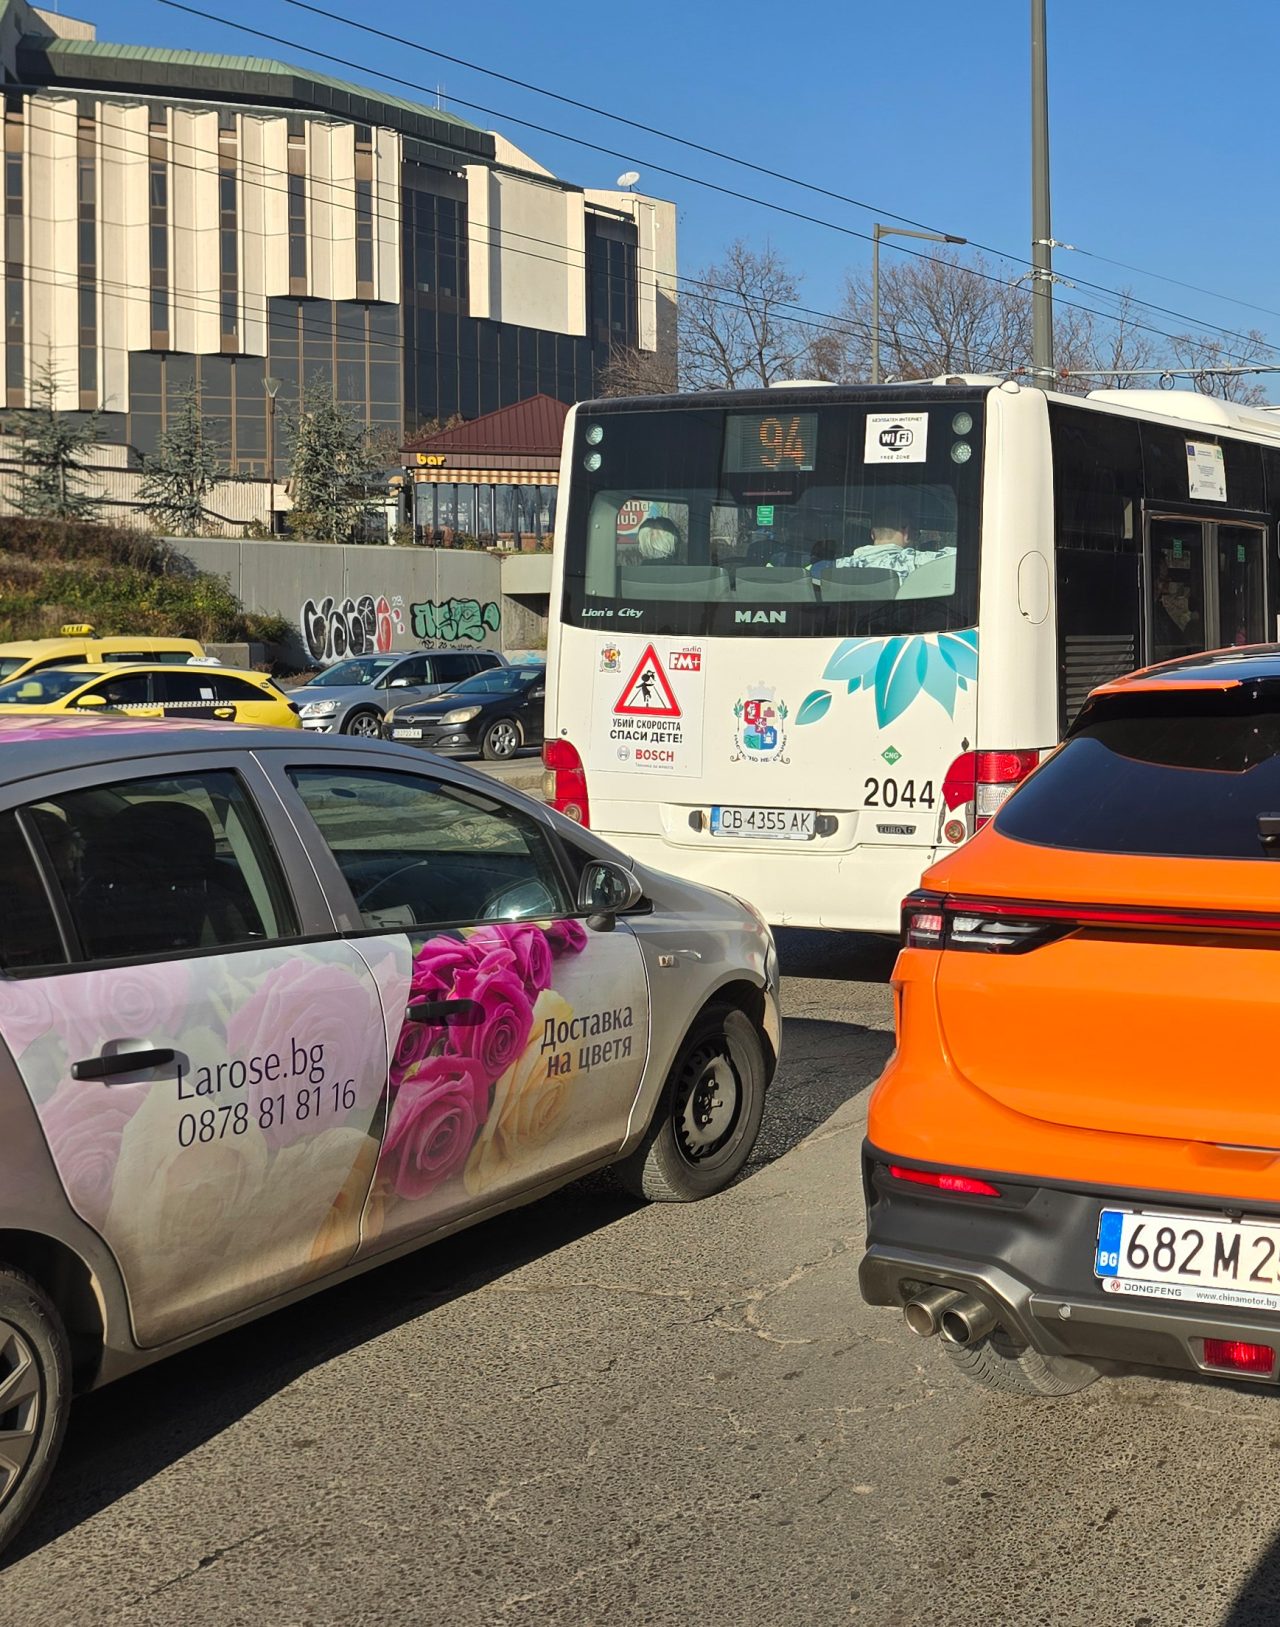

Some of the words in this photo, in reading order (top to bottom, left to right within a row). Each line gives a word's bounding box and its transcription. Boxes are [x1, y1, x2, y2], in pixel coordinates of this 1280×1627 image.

[759, 416, 806, 468] 94
[416, 453, 446, 466] bar
[582, 608, 613, 617] Lion's
[617, 608, 643, 618] City
[735, 610, 786, 623] MAN
[669, 653, 701, 671] FM+
[613, 717, 634, 729] УБИЙ
[637, 719, 681, 731] СКОРОСТТА
[610, 730, 648, 741] СПАСИ
[650, 732, 683, 743] ДЕТЕ!
[635, 749, 674, 761] BOSCH
[884, 751, 899, 760] CNG
[863, 777, 935, 809] 2044
[721, 810, 742, 829] CB
[747, 811, 786, 830] 4355
[790, 812, 811, 832] AK
[541, 1006, 633, 1055] Доставка
[547, 1051, 572, 1078] на
[579, 1036, 632, 1073] цветя
[177, 1037, 325, 1100] Larose.bg
[178, 1102, 249, 1147] 0878
[258, 1094, 285, 1129] 81
[296, 1086, 321, 1120] 81
[331, 1079, 356, 1112] 16
[1100, 1251, 1118, 1267] BG
[1127, 1224, 1204, 1276] 682
[1213, 1231, 1241, 1280] M
[1124, 1283, 1182, 1296] DONGFENG
[1196, 1290, 1278, 1308] www.chinamotor.bg
